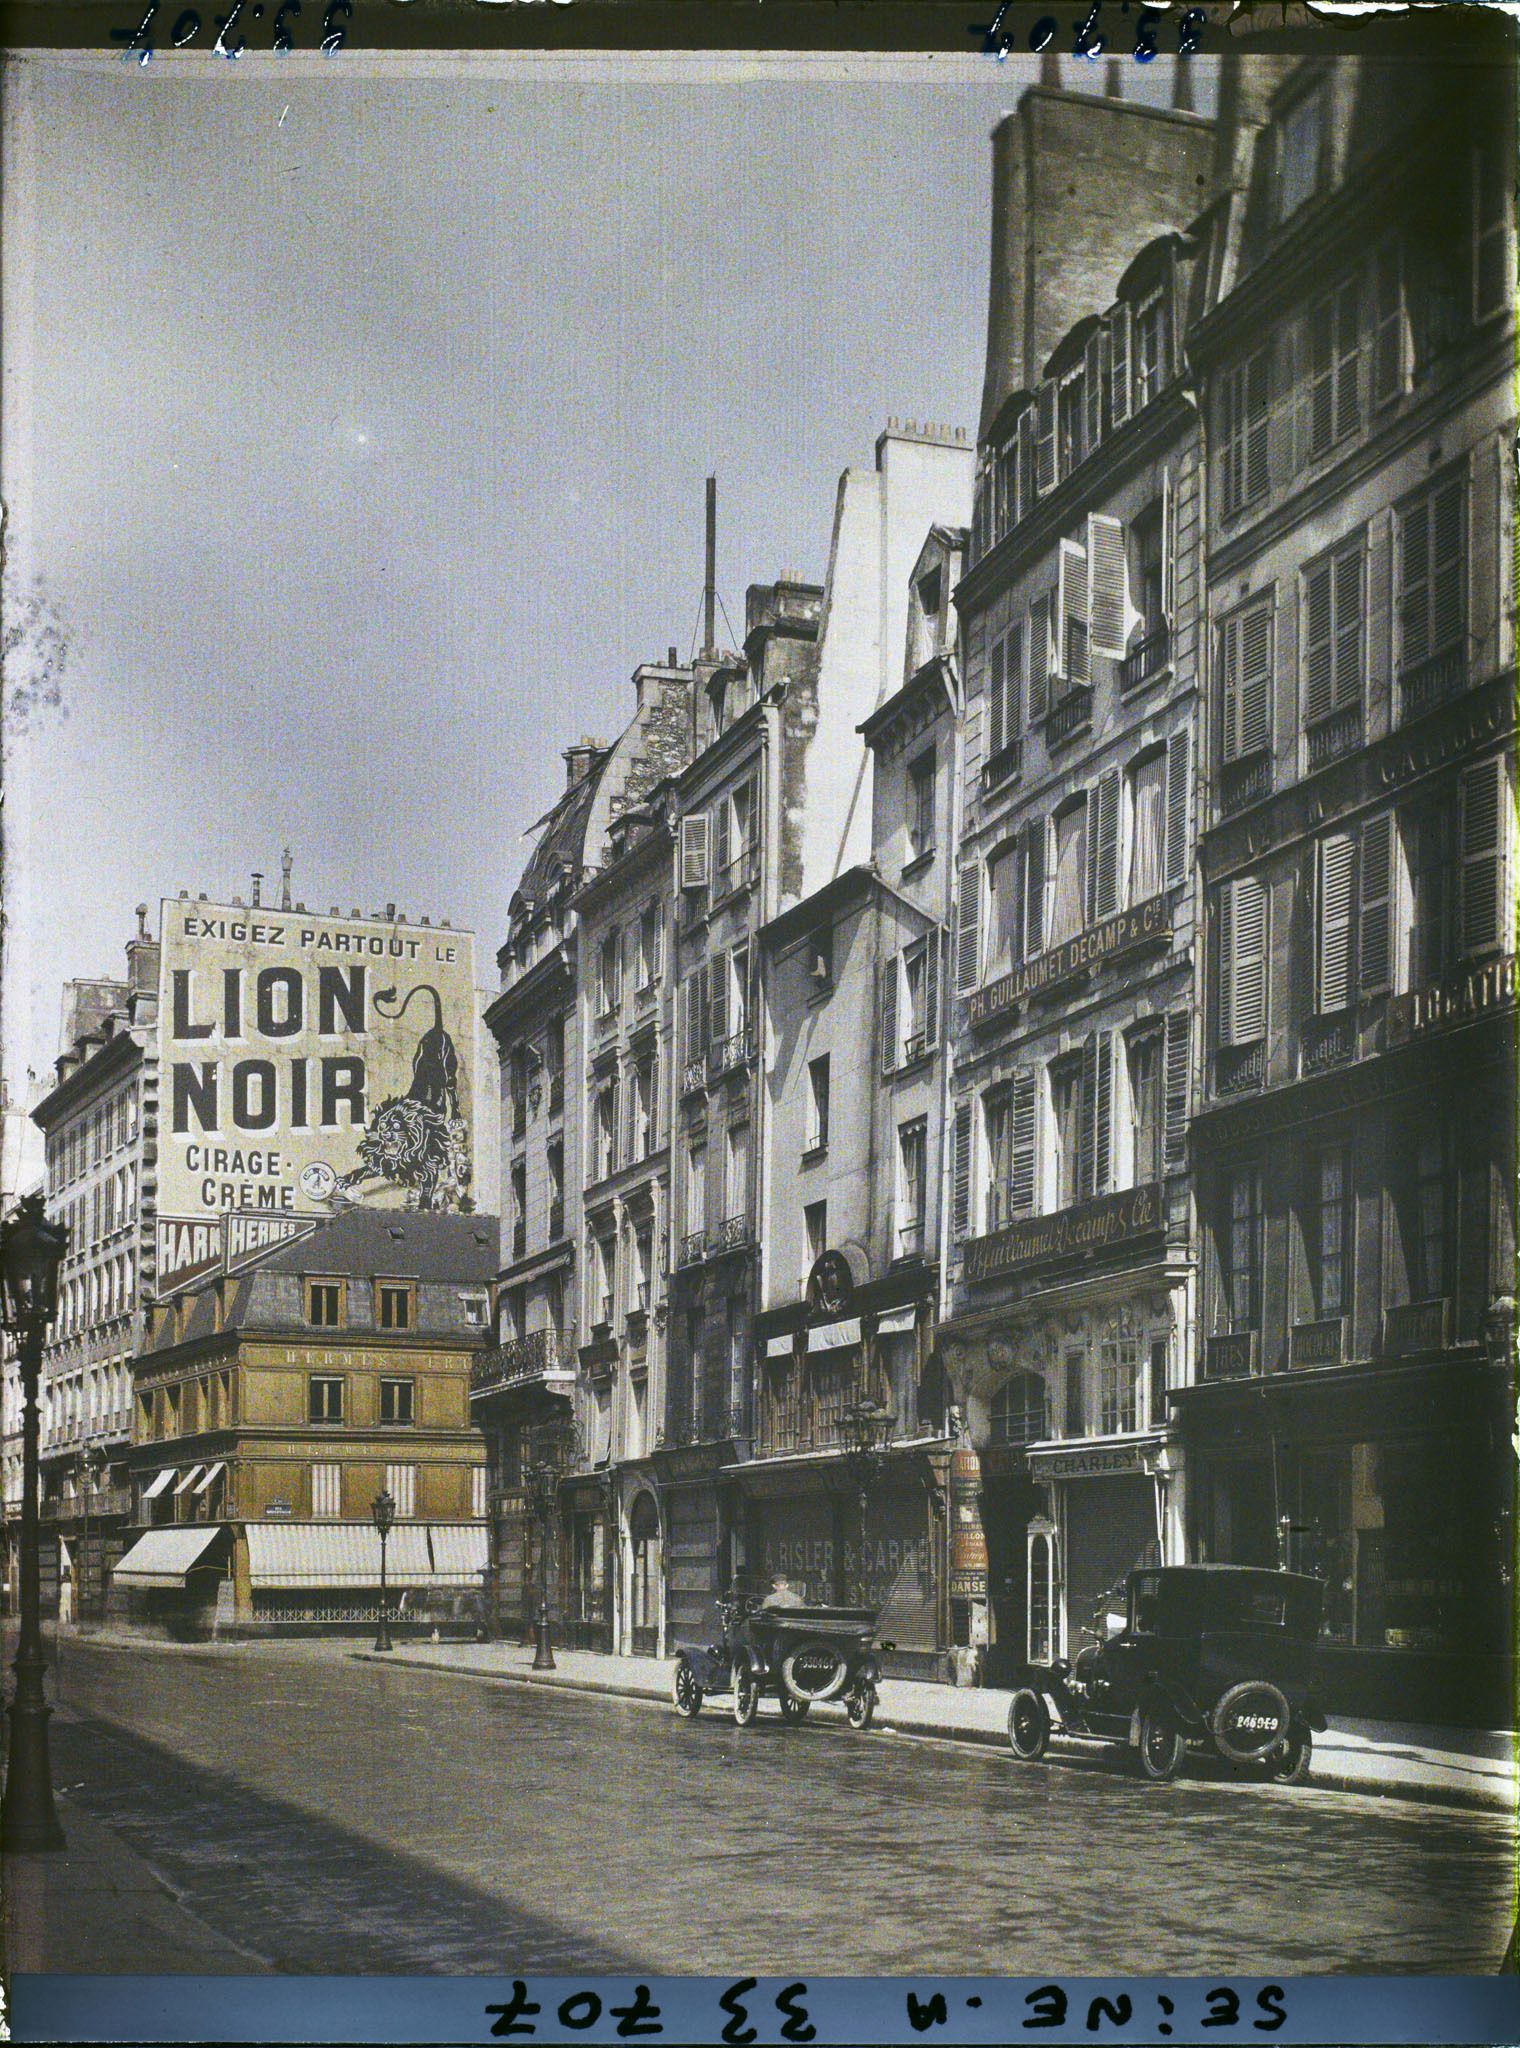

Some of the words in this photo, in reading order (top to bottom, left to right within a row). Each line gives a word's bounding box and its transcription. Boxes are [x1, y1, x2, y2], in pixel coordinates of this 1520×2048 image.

[184, 917, 285, 945] EXIGEZ
[301, 930, 420, 958] PARTOUT
[435, 947, 456, 964] LE
[1070, 919, 1126, 967] DECAMP
[1130, 918, 1138, 938] &
[172, 966, 368, 1040] LION
[172, 1056, 368, 1133] NOIR
[1053, 1453, 1136, 1474] CHARLEY
[844, 1540, 856, 1572] &
[951, 1581, 986, 1593] DANSE
